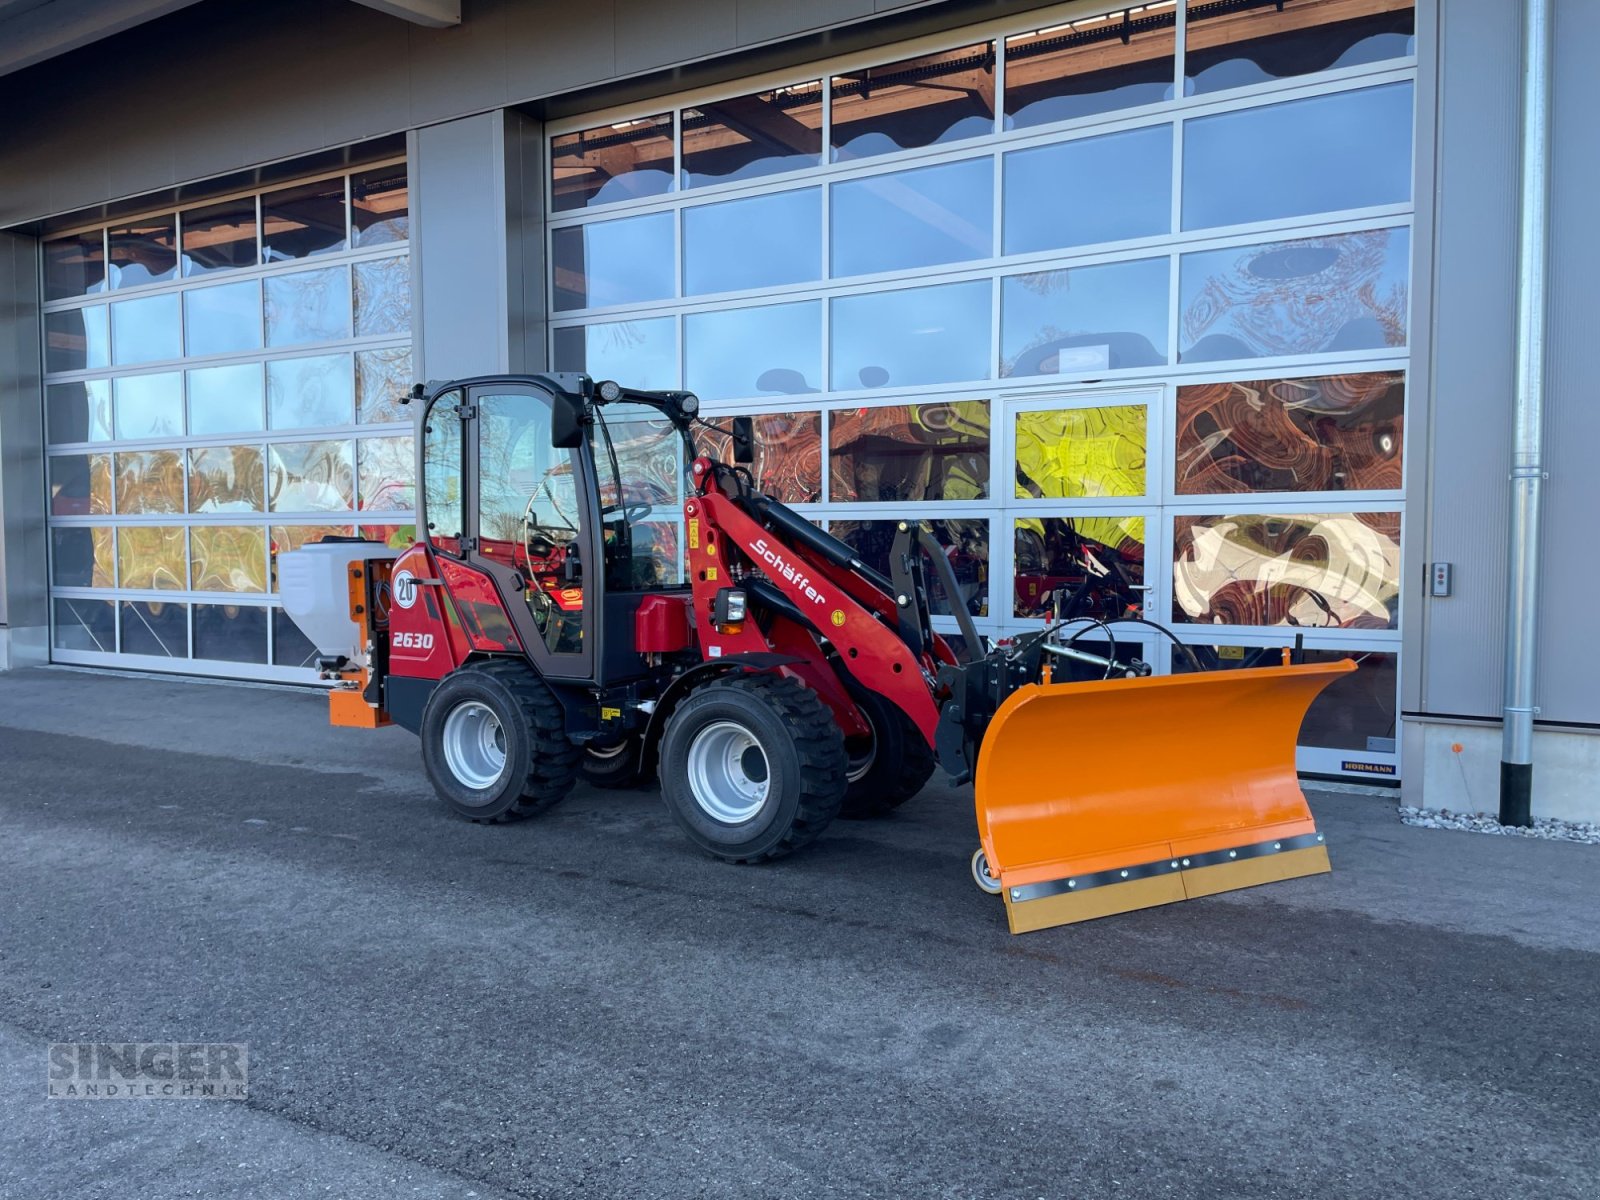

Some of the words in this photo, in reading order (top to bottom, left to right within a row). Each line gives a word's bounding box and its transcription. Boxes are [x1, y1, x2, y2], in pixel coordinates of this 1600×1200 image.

[749, 539, 826, 604] Schäffer
[398, 578, 413, 601] 20
[392, 632, 434, 649] 2630
